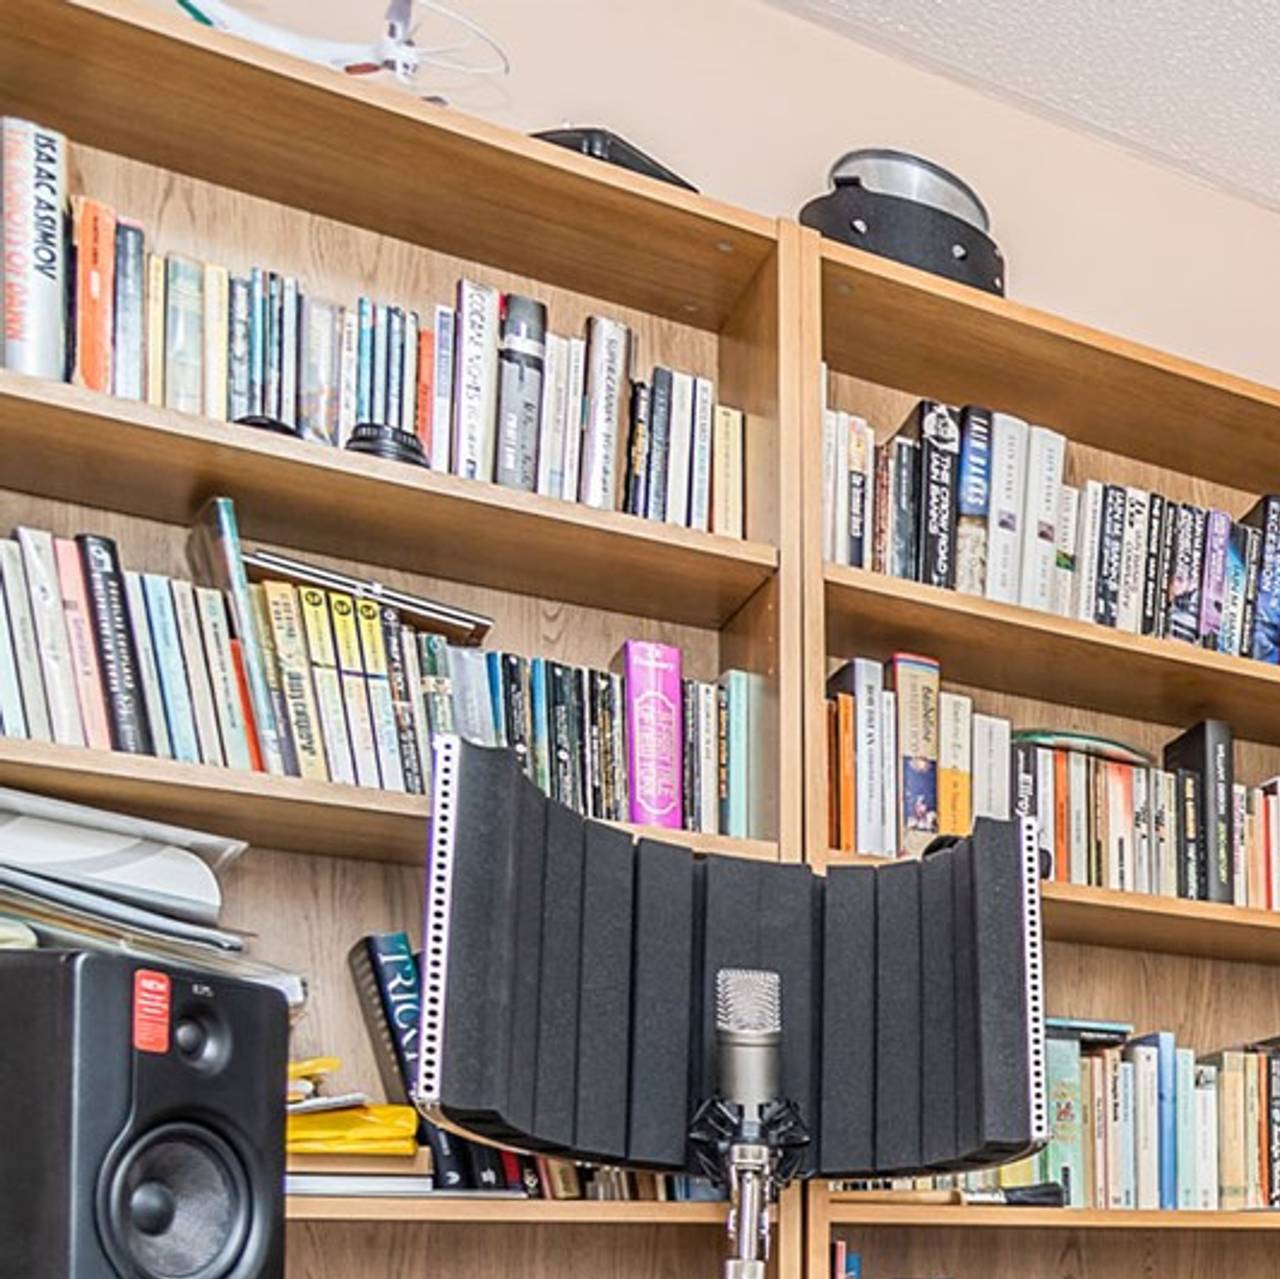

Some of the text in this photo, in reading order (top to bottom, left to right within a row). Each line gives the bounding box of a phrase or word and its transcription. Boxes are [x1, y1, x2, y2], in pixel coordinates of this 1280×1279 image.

[34, 133, 57, 281] ISAAC ASIMOV
[5, 283, 26, 340] DAWN
[928, 451, 942, 534] IAIN BANKS
[967, 416, 989, 506] IAIN BANKS
[937, 455, 951, 574] THE CROW ROAD
[1263, 501, 1279, 592] EXCESSION
[115, 633, 133, 689] COUPLAND
[1016, 773, 1033, 819] Ellroy
